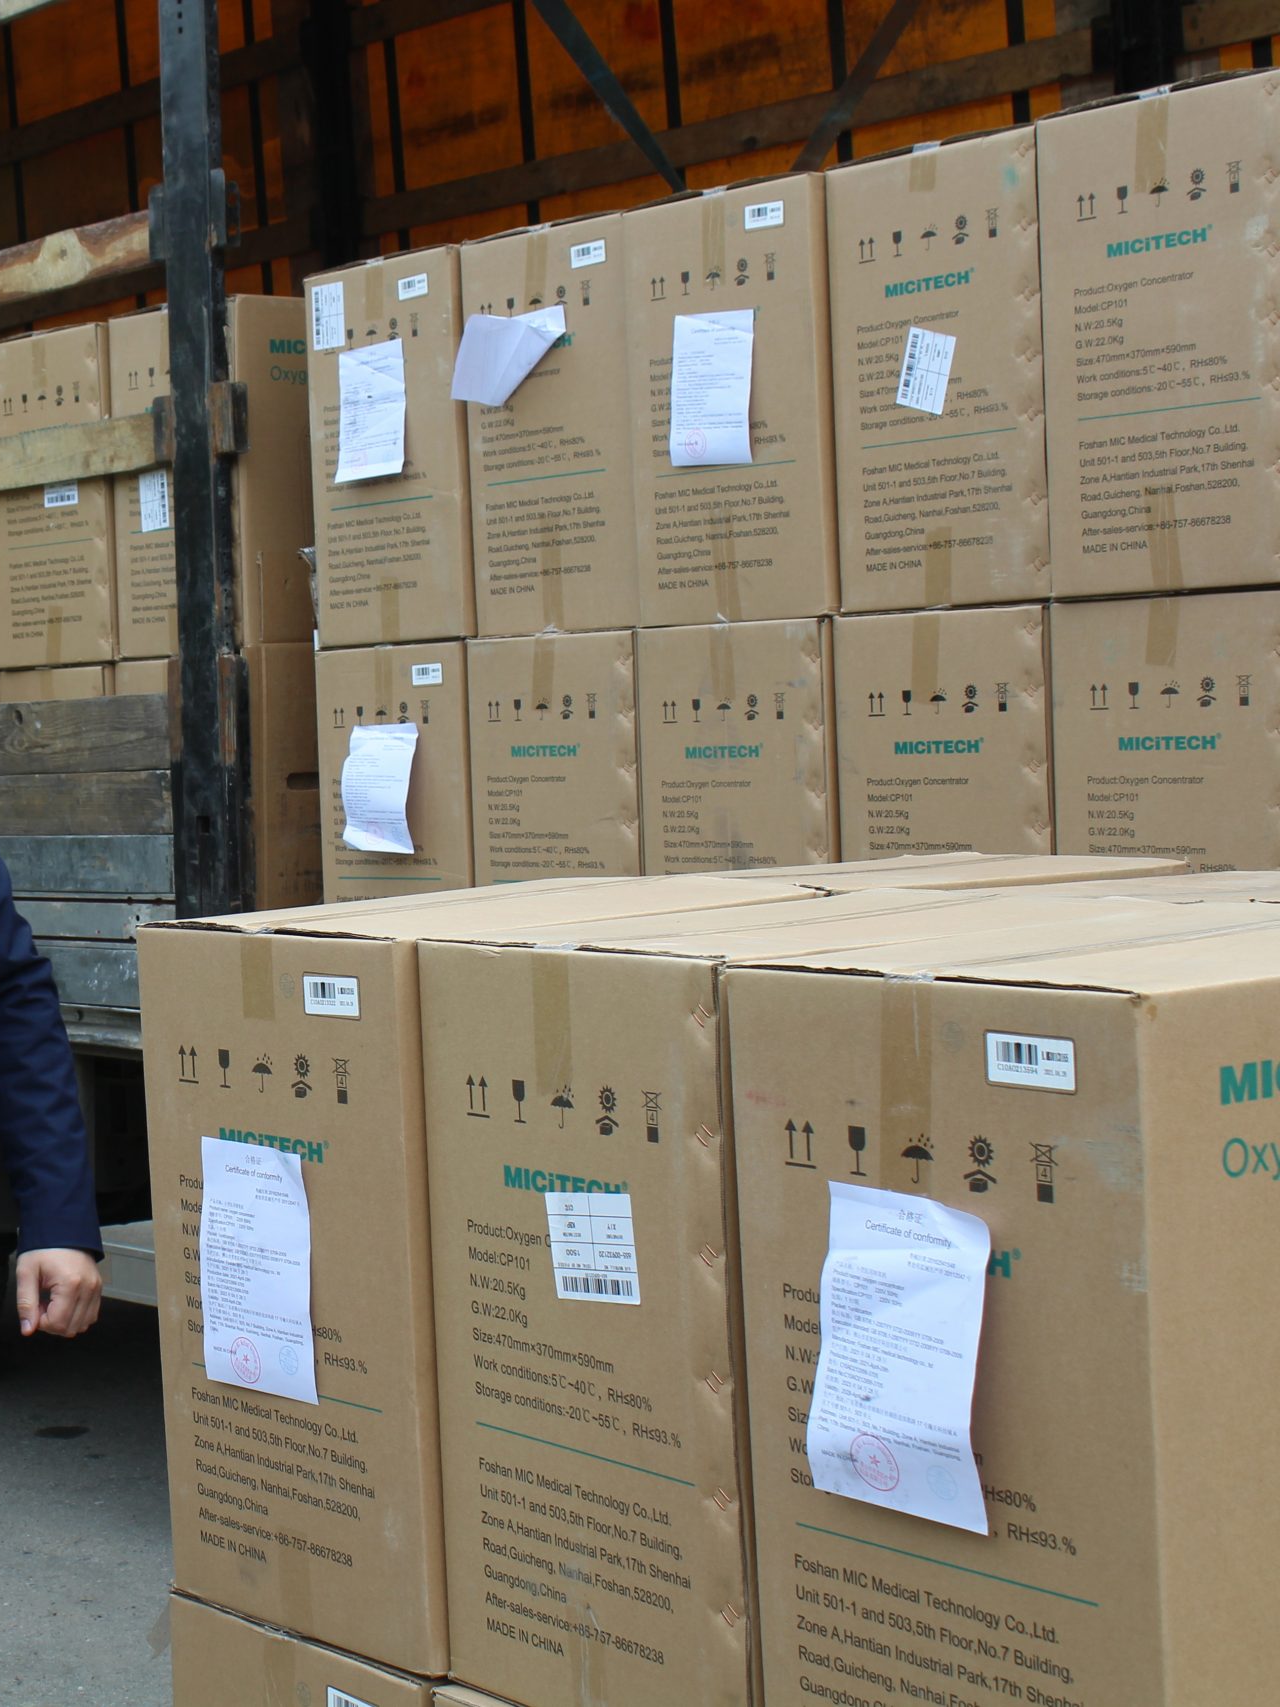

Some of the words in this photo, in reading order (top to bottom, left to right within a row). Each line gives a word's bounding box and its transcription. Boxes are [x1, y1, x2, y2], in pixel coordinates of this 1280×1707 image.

[922, 776, 969, 786] Concentrator
[1150, 775, 1203, 785] Concentrator
[865, 1219, 902, 1238] Certificate
[904, 1229, 913, 1239] of
[912, 1233, 952, 1249] conformity
[468, 1245, 530, 1271] Model:CP101
[473, 1352, 498, 1372] Work
[474, 1380, 512, 1406] Storage
[191, 1387, 221, 1406] Foshan
[222, 1395, 239, 1411] MIC
[240, 1400, 272, 1420] Medical
[273, 1408, 322, 1436] Technology
[192, 1411, 209, 1427] Unit
[210, 1416, 232, 1434] 501-1
[234, 1425, 251, 1438] and
[193, 1435, 214, 1452] Zone
[215, 1441, 255, 1464] A,Hantian
[257, 1452, 294, 1475] Industrial
[296, 1464, 337, 1488] Park,17th
[338, 1477, 375, 1500] Shenhai
[478, 1456, 513, 1479] Foshan
[514, 1466, 534, 1485] MIC
[536, 1473, 572, 1496] Medical
[574, 1483, 630, 1516] Technology
[479, 1483, 499, 1501] Unit
[500, 1489, 526, 1510] 501-1
[528, 1501, 547, 1516] and
[199, 1529, 225, 1549] MADE
[227, 1538, 236, 1553] IN
[237, 1542, 267, 1563] CHINA
[481, 1510, 505, 1530] Zone
[506, 1518, 552, 1545] A,Hantian
[554, 1532, 597, 1559] Industrial
[599, 1547, 647, 1575] Park,17th
[648, 1563, 691, 1590] Shenhai
[794, 1554, 839, 1581] Foshan
[842, 1567, 869, 1589] MIC
[871, 1575, 921, 1604] Medical
[923, 1590, 1001, 1630] Technology
[795, 1584, 820, 1606] Unit
[822, 1593, 856, 1617] 501-1
[861, 1607, 886, 1625] and
[486, 1616, 516, 1640] MADE
[518, 1628, 529, 1644] IN
[531, 1633, 564, 1657] CHINA
[796, 1614, 828, 1638] Zone
[830, 1625, 892, 1658] A,Hantian
[895, 1644, 954, 1677] Industrial
[957, 1663, 1022, 1699] Park,17th
